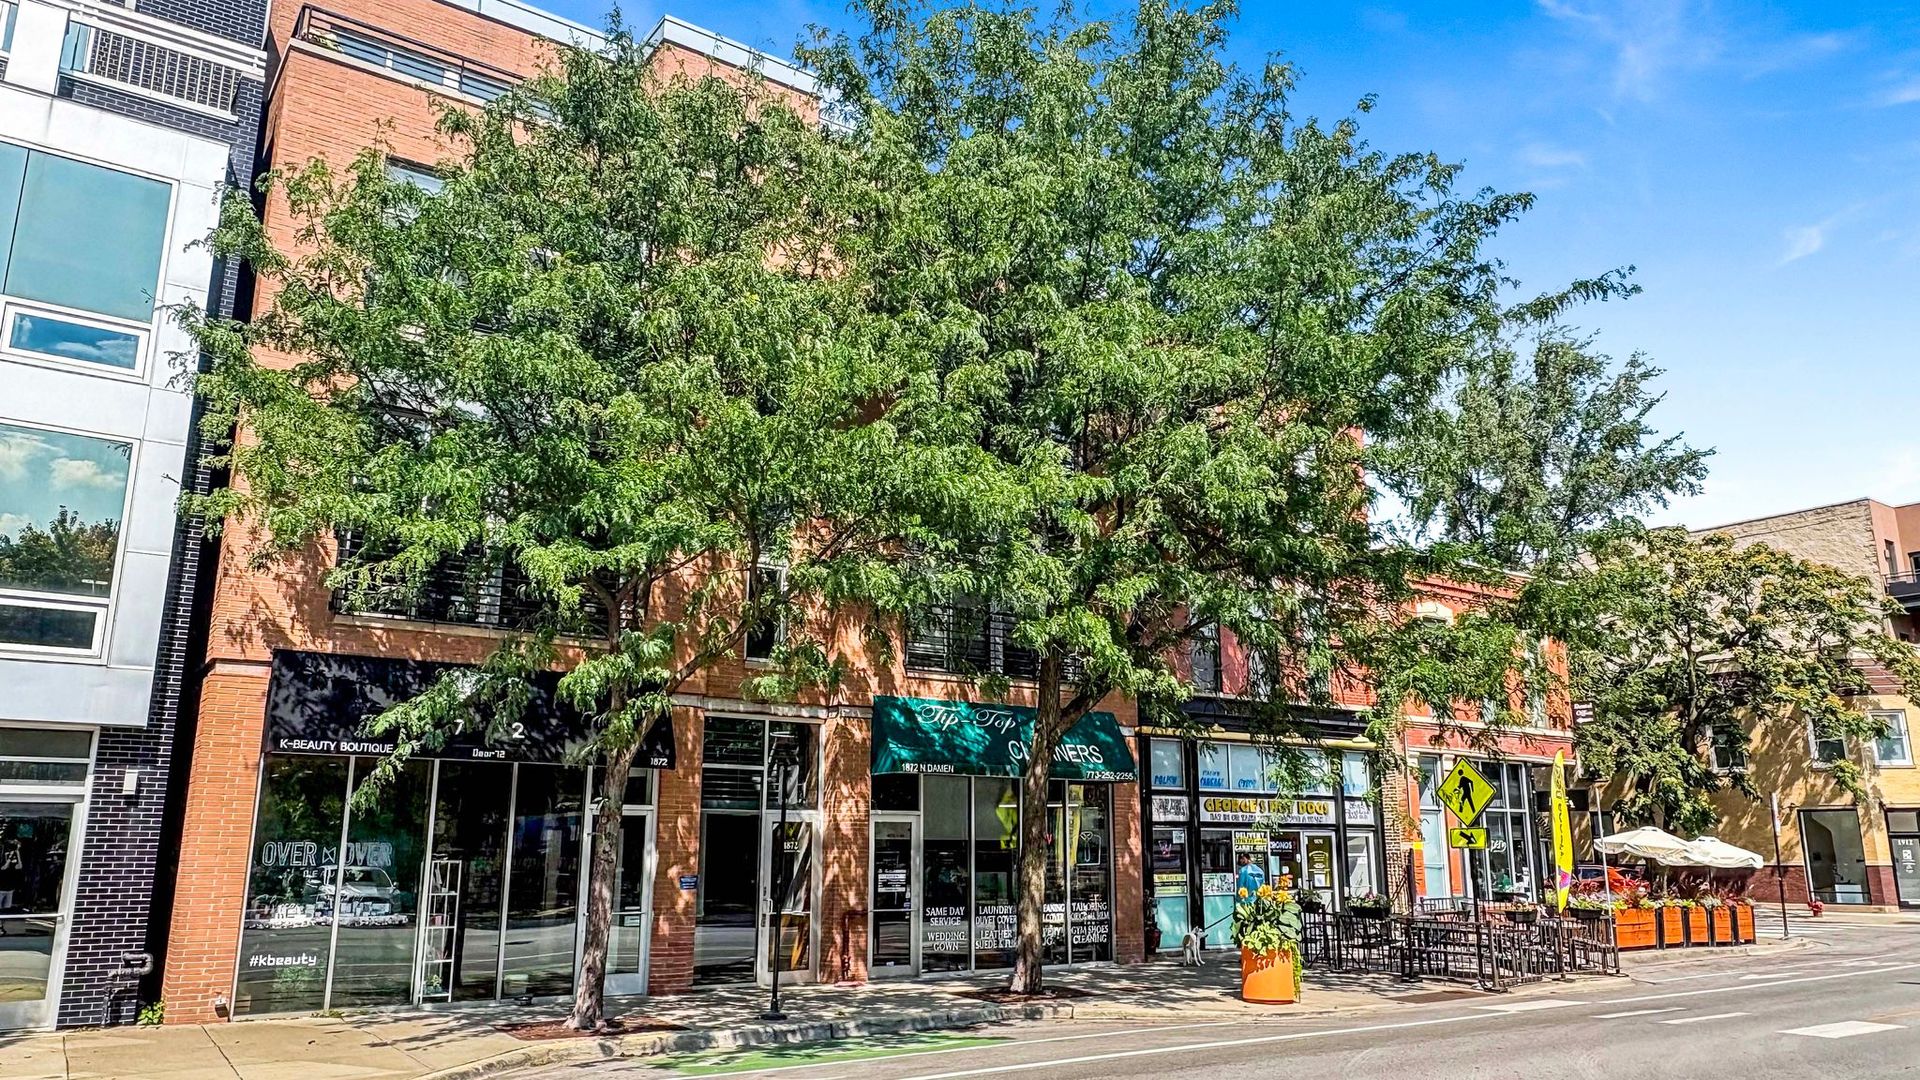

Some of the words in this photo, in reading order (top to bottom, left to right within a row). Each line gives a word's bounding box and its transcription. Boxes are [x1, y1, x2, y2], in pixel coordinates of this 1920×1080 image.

[280, 738, 337, 751] K-BEAUTY
[340, 742, 394, 754] BOUTIQUE
[1007, 740, 1104, 763] CLNERS
[651, 758, 668, 766] 1872
[901, 763, 918, 772] 1872
[928, 765, 954, 773] DAMEN
[262, 841, 318, 867] OVER
[925, 907, 947, 916] SAME
[949, 906, 965, 916] DAY
[979, 905, 1013, 914] LAUNDRY
[930, 917, 961, 926] SERVICE
[928, 931, 965, 941] WEDDING
[981, 930, 1012, 940] LEATHER
[1073, 935, 1107, 944] CLEANING
[934, 941, 959, 951] GOWN
[249, 953, 317, 966] #kbeauty
